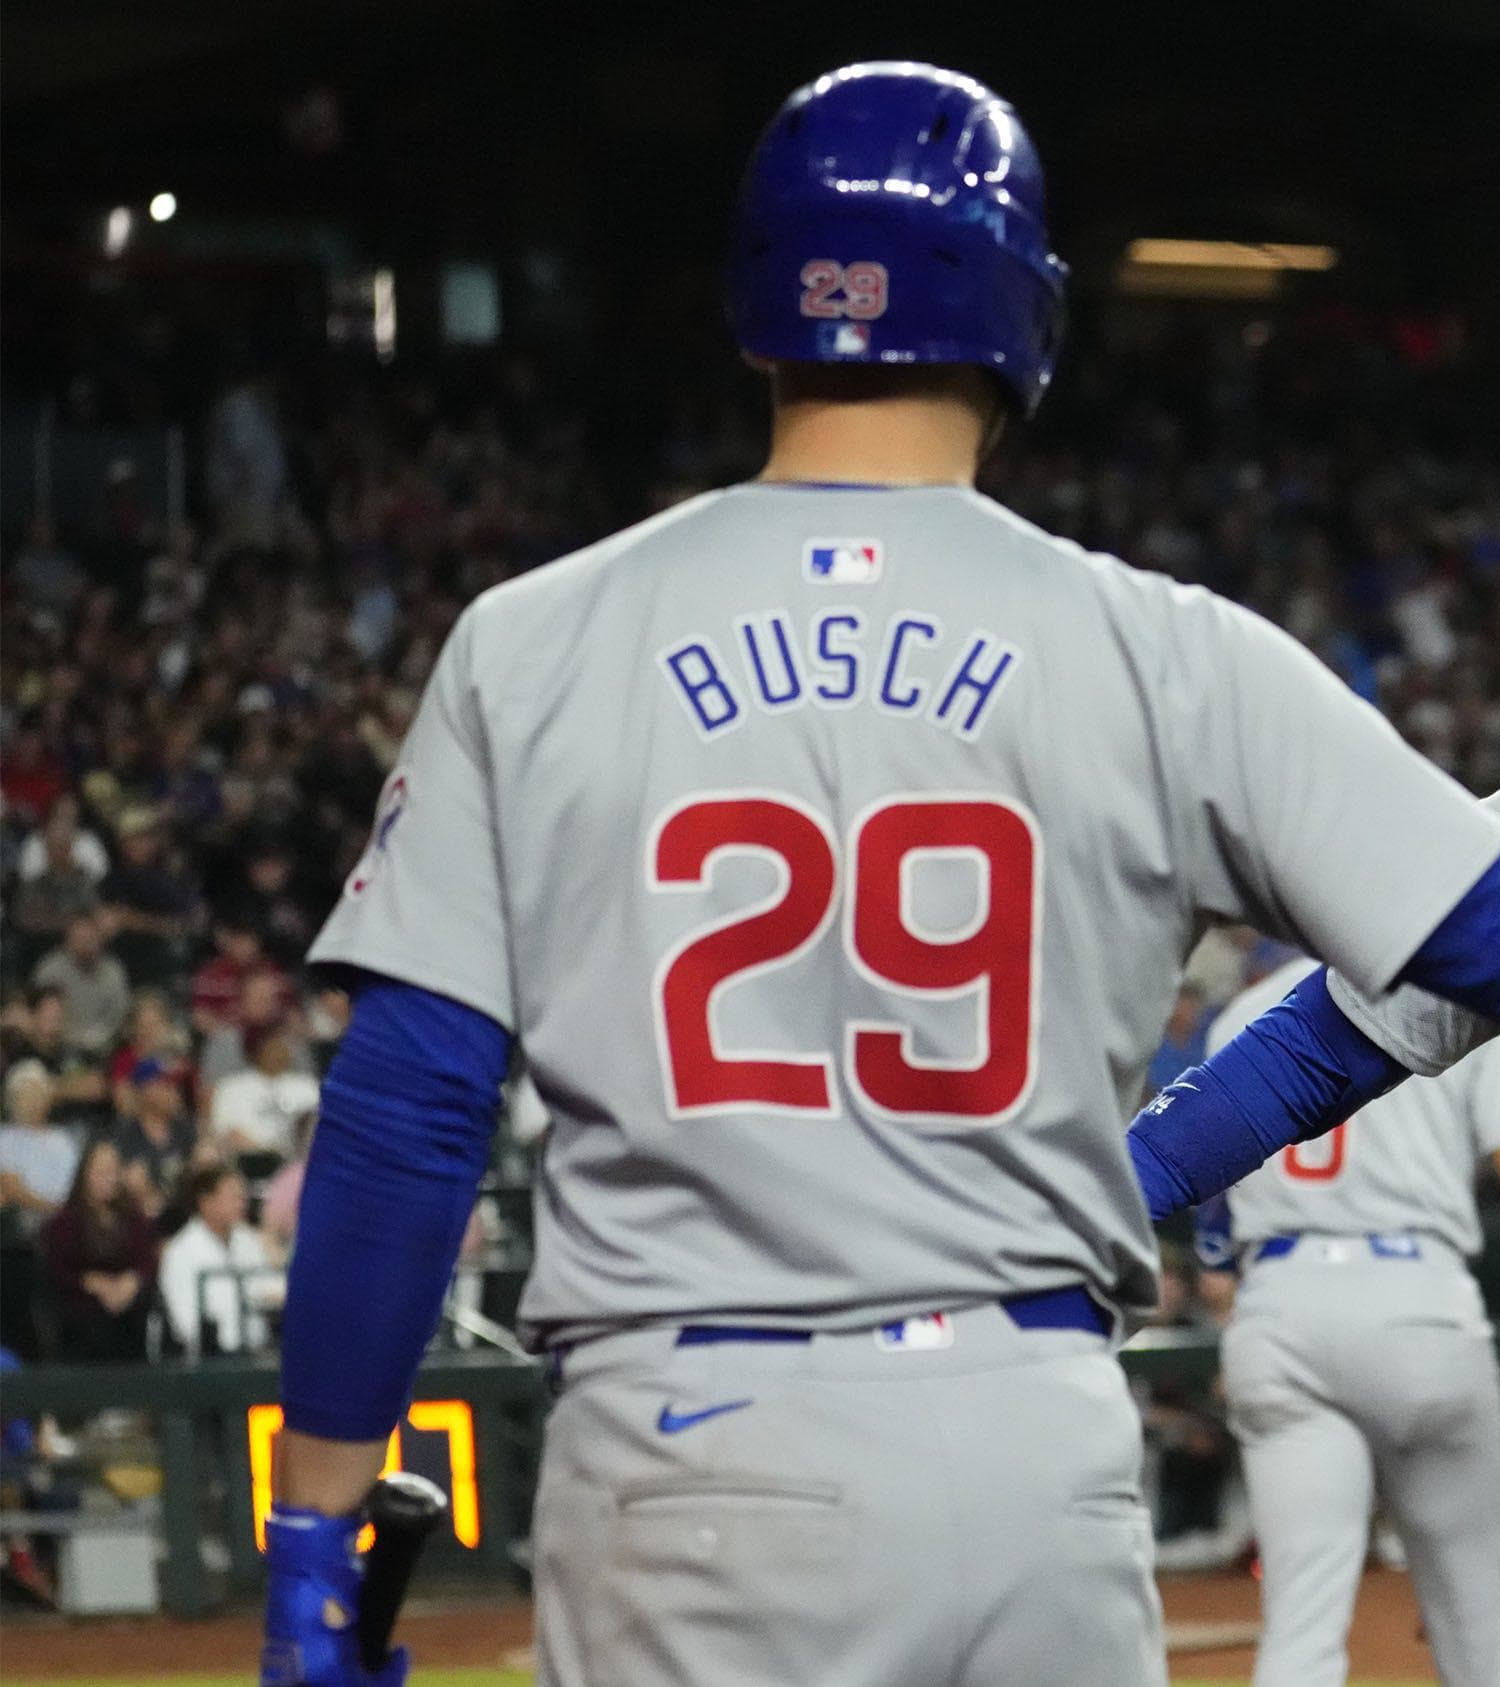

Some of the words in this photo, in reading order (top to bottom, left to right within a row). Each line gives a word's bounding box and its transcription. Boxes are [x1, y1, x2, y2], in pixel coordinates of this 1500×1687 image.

[800, 259, 889, 320] 29
[658, 606, 1022, 740] BUSCH
[645, 788, 1045, 1128] 29
